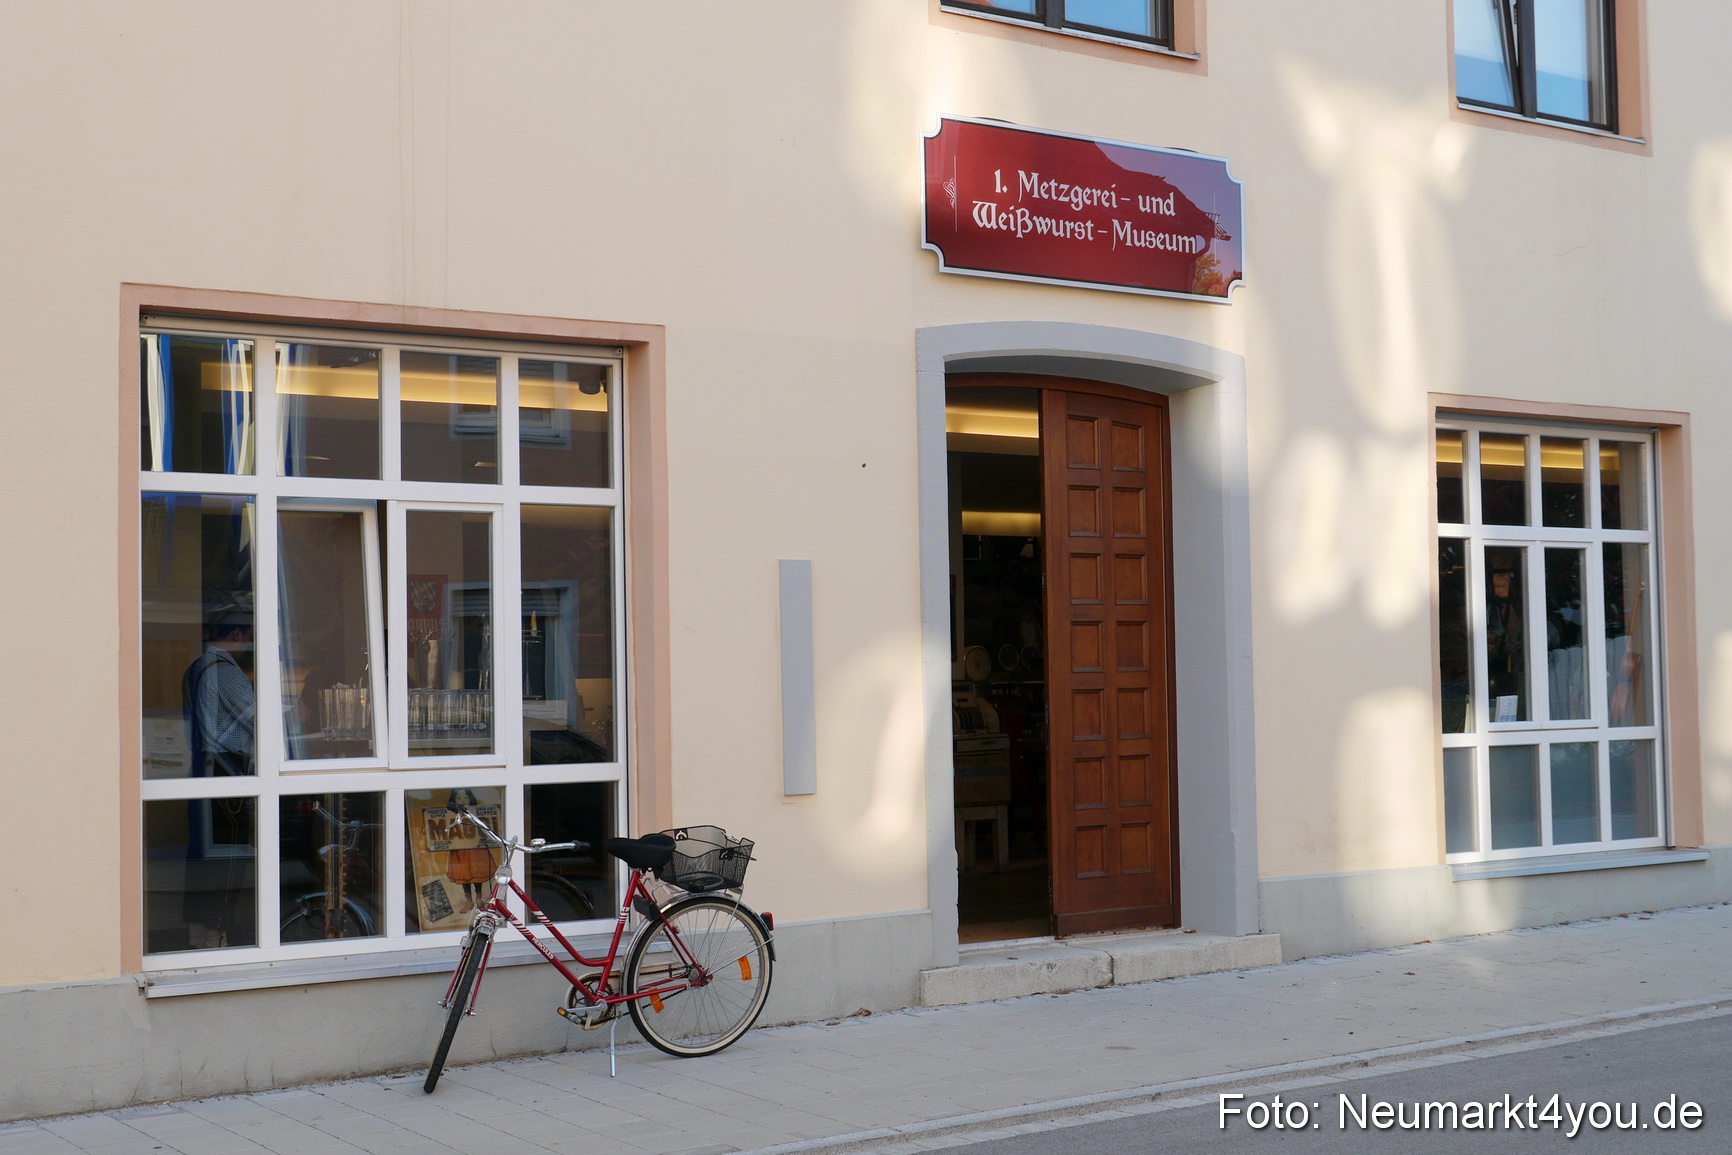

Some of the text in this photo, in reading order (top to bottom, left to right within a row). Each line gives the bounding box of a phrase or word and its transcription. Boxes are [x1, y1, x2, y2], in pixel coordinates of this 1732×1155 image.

[994, 169, 1008, 193] 1.
[1138, 192, 1176, 217] und
[531, 936, 554, 960] HERCULES
